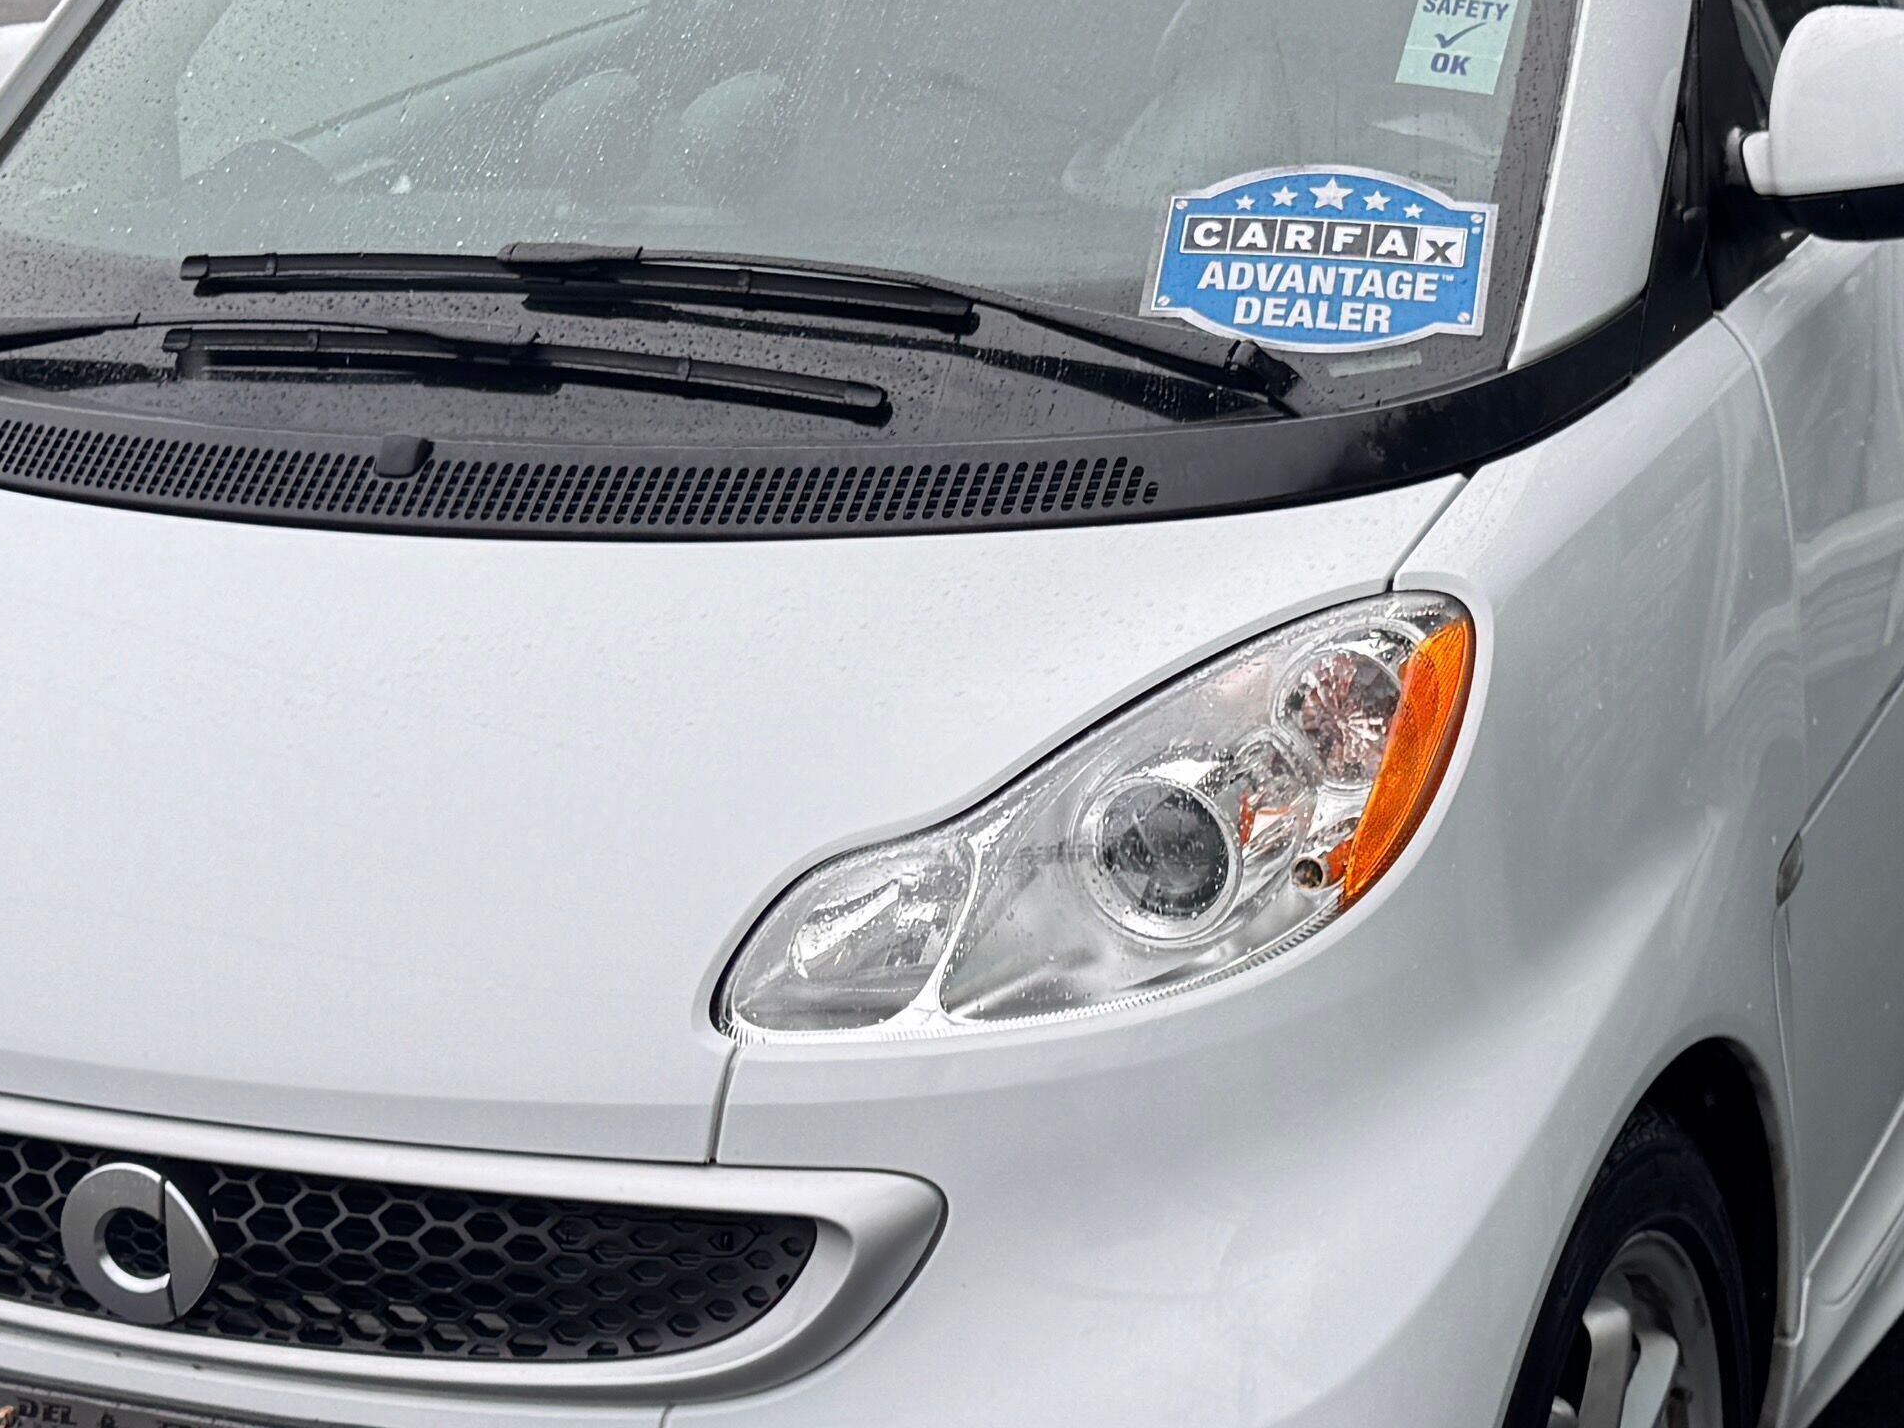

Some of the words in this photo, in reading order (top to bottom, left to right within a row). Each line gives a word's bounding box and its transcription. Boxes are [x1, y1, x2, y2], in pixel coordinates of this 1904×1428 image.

[1430, 52, 1472, 77] OK
[1192, 220, 1458, 265] CARFAX
[1232, 296, 1393, 334] DEALER
[16, 1396, 78, 1426] DEL
